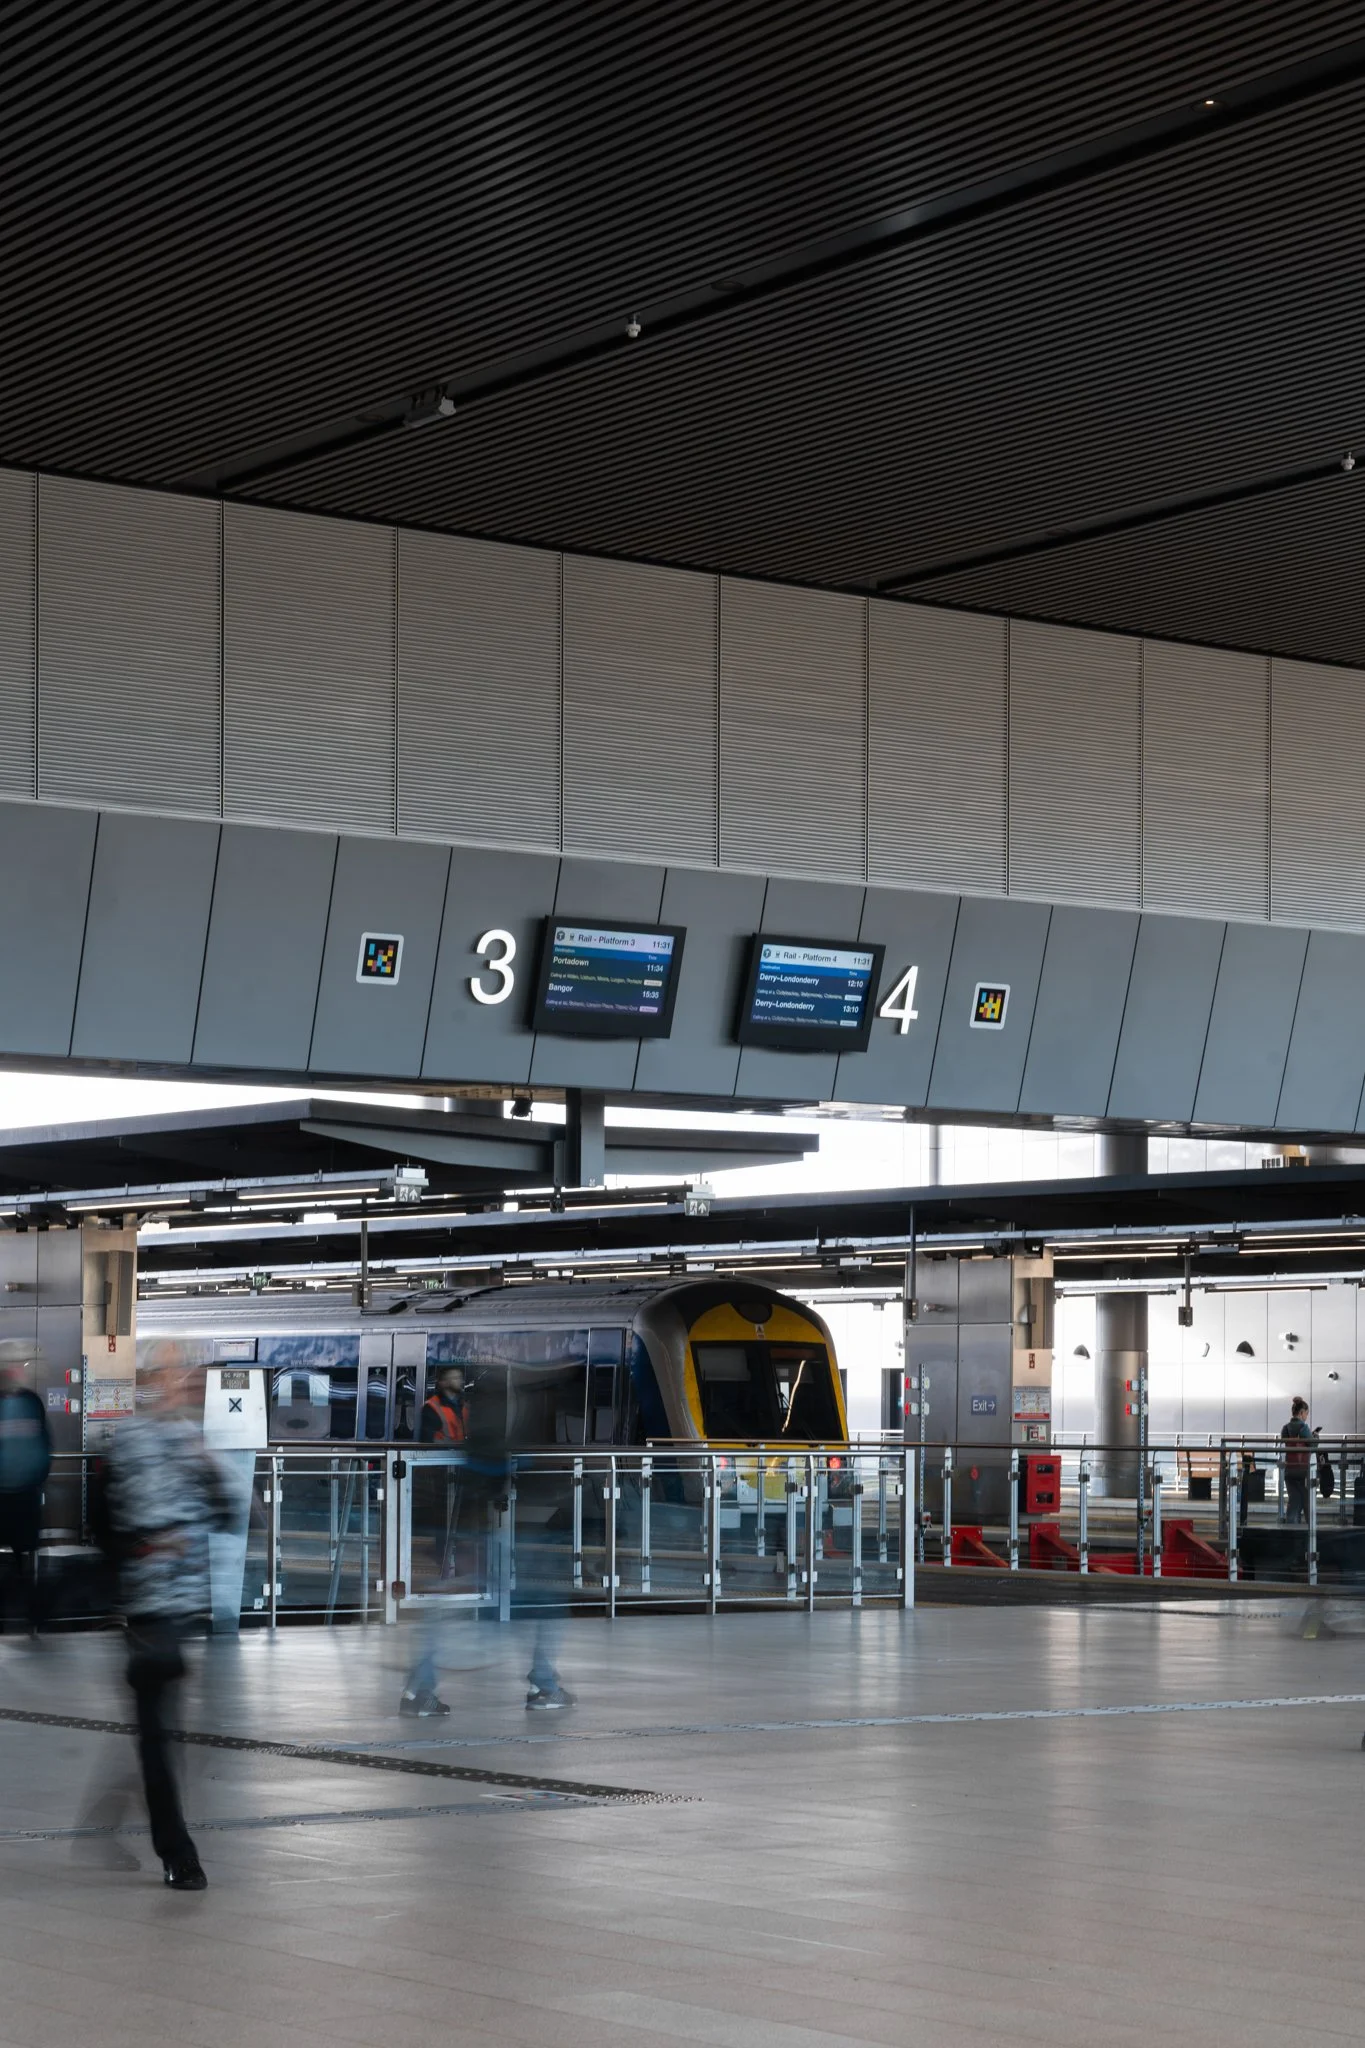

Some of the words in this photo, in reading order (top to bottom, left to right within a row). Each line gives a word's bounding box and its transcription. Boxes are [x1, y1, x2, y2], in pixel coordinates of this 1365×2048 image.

[578, 934, 592, 943] Rail
[598, 935, 629, 946] Platform
[652, 941, 670, 949] 11:31
[552, 956, 589, 967] Portadown
[783, 951, 797, 959] Rail
[802, 952, 832, 962] Platform
[853, 957, 870, 965] 11:31
[470, 929, 516, 1005] 3
[646, 964, 664, 972] 11:34
[548, 983, 573, 993] Bangor
[847, 980, 864, 988] 12:10
[880, 965, 918, 1035] 4
[843, 1005, 859, 1014] 13:10
[972, 1399, 987, 1412] Exit
